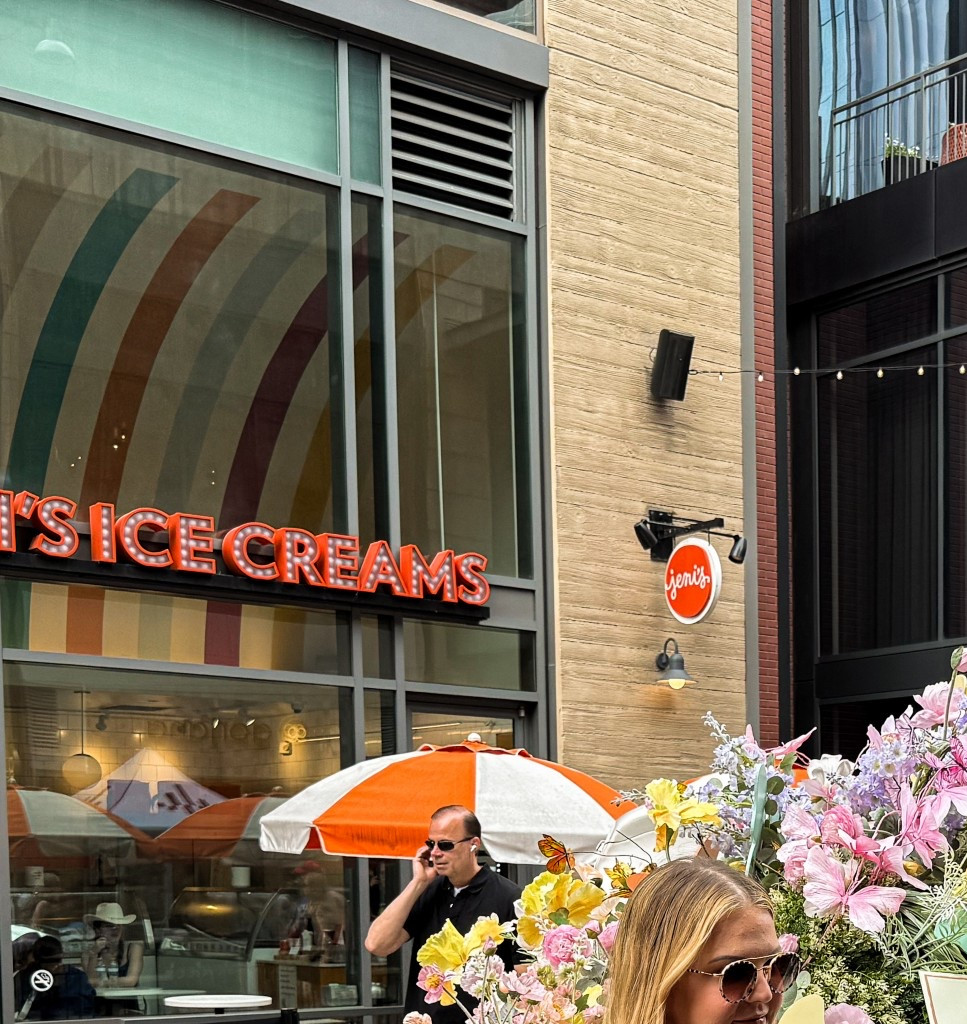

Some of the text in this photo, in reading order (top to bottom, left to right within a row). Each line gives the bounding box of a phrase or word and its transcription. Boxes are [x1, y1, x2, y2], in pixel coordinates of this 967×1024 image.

[89, 502, 217, 574] ICE
[222, 522, 490, 606] CREAMS
[665, 565, 711, 600] jeni's
